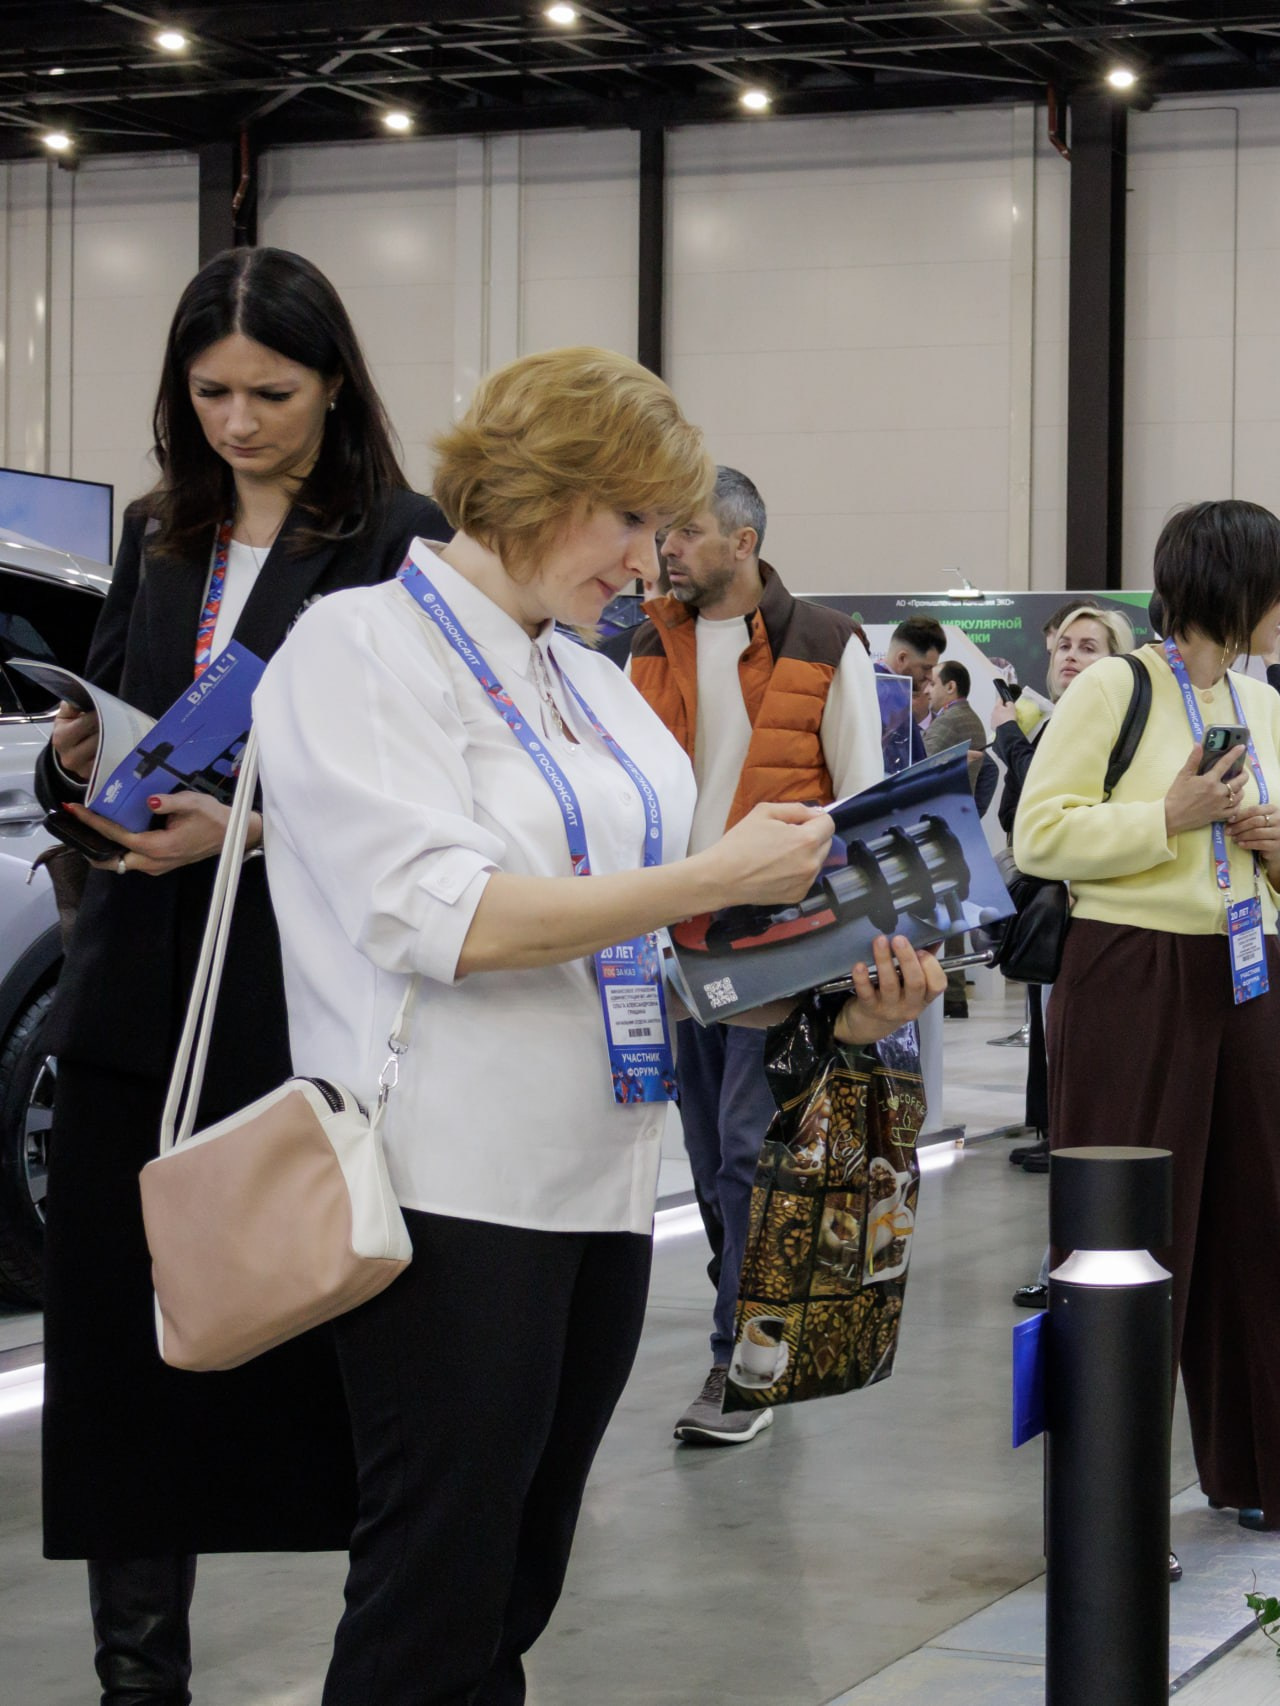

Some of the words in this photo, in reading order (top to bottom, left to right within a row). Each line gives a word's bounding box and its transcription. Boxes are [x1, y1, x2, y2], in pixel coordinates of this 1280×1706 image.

[430, 603, 480, 666] ГОСКОНСАЛТ
[536, 753, 578, 827] ГОСКОНСАЛТ
[615, 946, 634, 959] ЛЕТ
[621, 1052, 660, 1063] УЧАСТНИК
[627, 1066, 659, 1077] ФОРУМА
